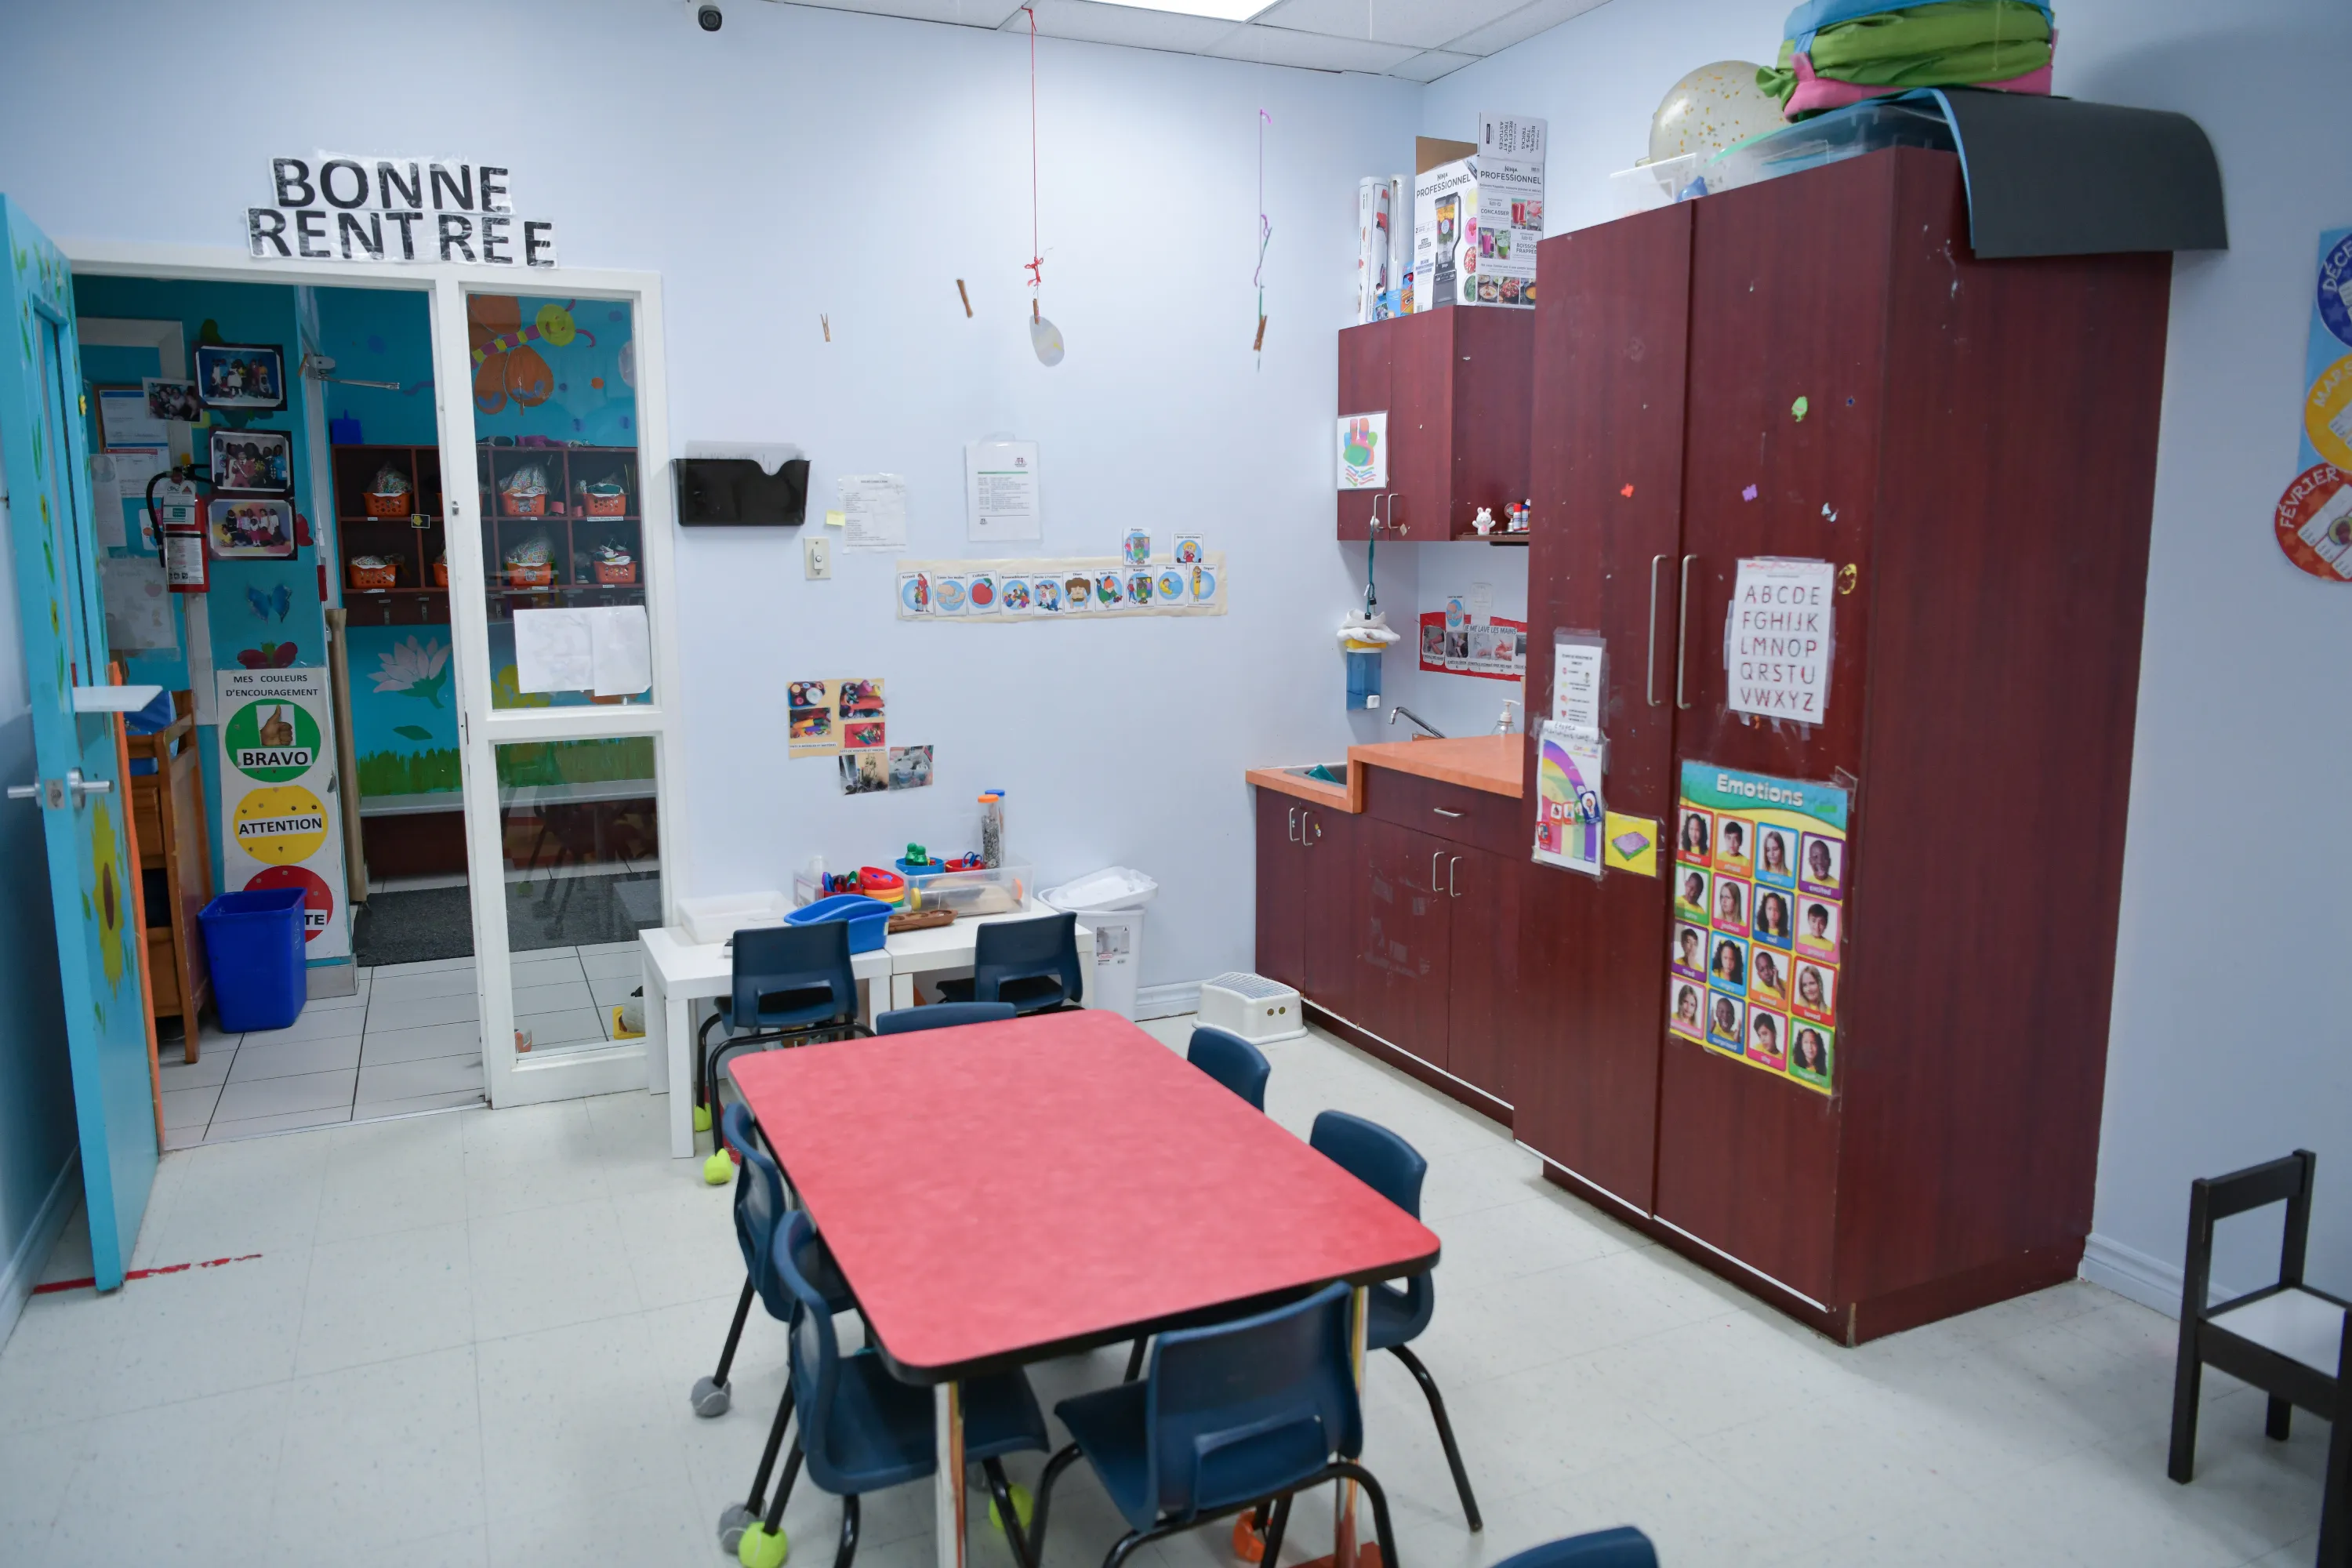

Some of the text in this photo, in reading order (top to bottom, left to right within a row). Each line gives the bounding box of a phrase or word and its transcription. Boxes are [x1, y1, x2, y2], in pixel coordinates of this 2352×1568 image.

[272, 157, 513, 214] BONNE
[1416, 173, 1471, 199] PROFESSIONNEL
[1480, 170, 1541, 185] PROFESSIONNEL
[247, 208, 555, 267] RENTREE
[2278, 466, 2340, 528] FÉVRIER
[260, 674, 308, 683] COULEURS
[242, 751, 309, 767] BRAVO
[1716, 773, 1804, 808] Emotions
[238, 817, 323, 835] ATTENTION
[1809, 885, 1831, 895] excited
[1804, 1010, 1820, 1021] loved
